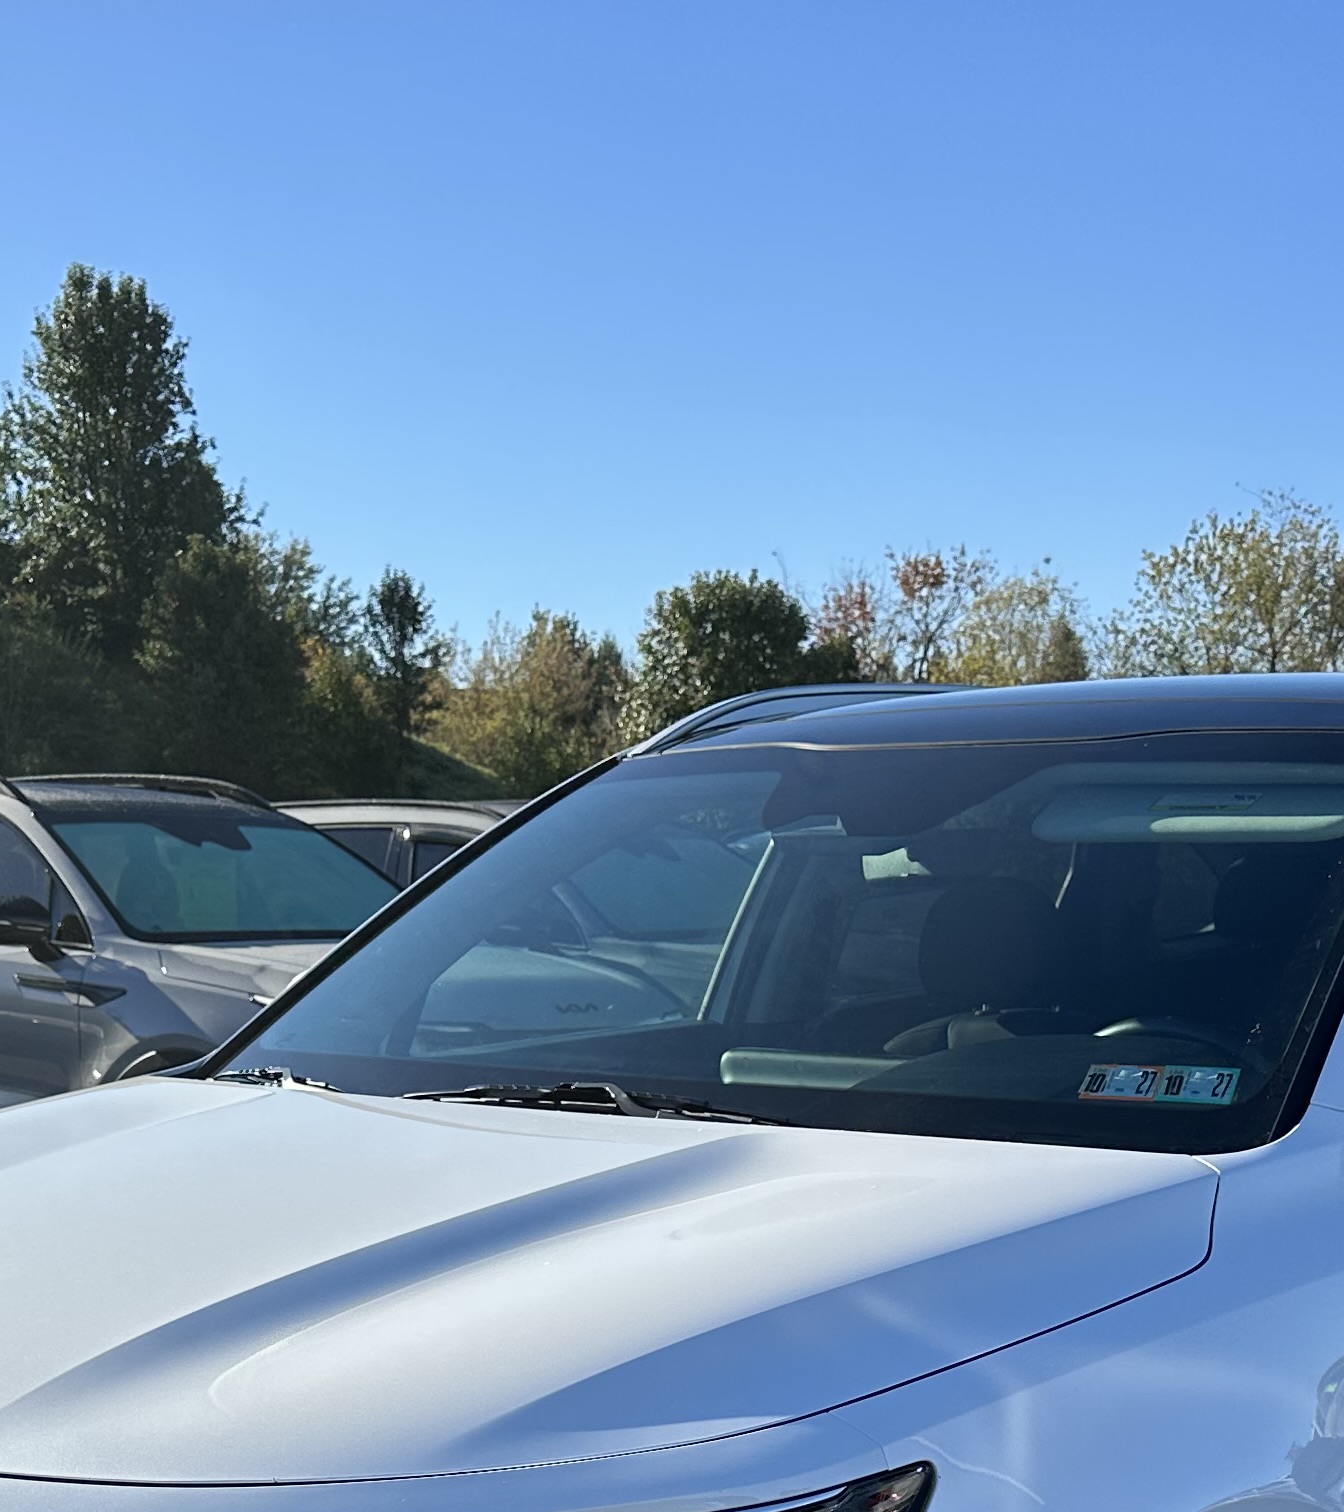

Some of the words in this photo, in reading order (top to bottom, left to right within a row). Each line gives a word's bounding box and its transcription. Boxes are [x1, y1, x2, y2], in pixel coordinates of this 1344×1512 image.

[1084, 1072, 1107, 1093] 10
[1135, 1070, 1158, 1096] 27
[1164, 1074, 1184, 1095] 10
[1211, 1072, 1234, 1098] 27
